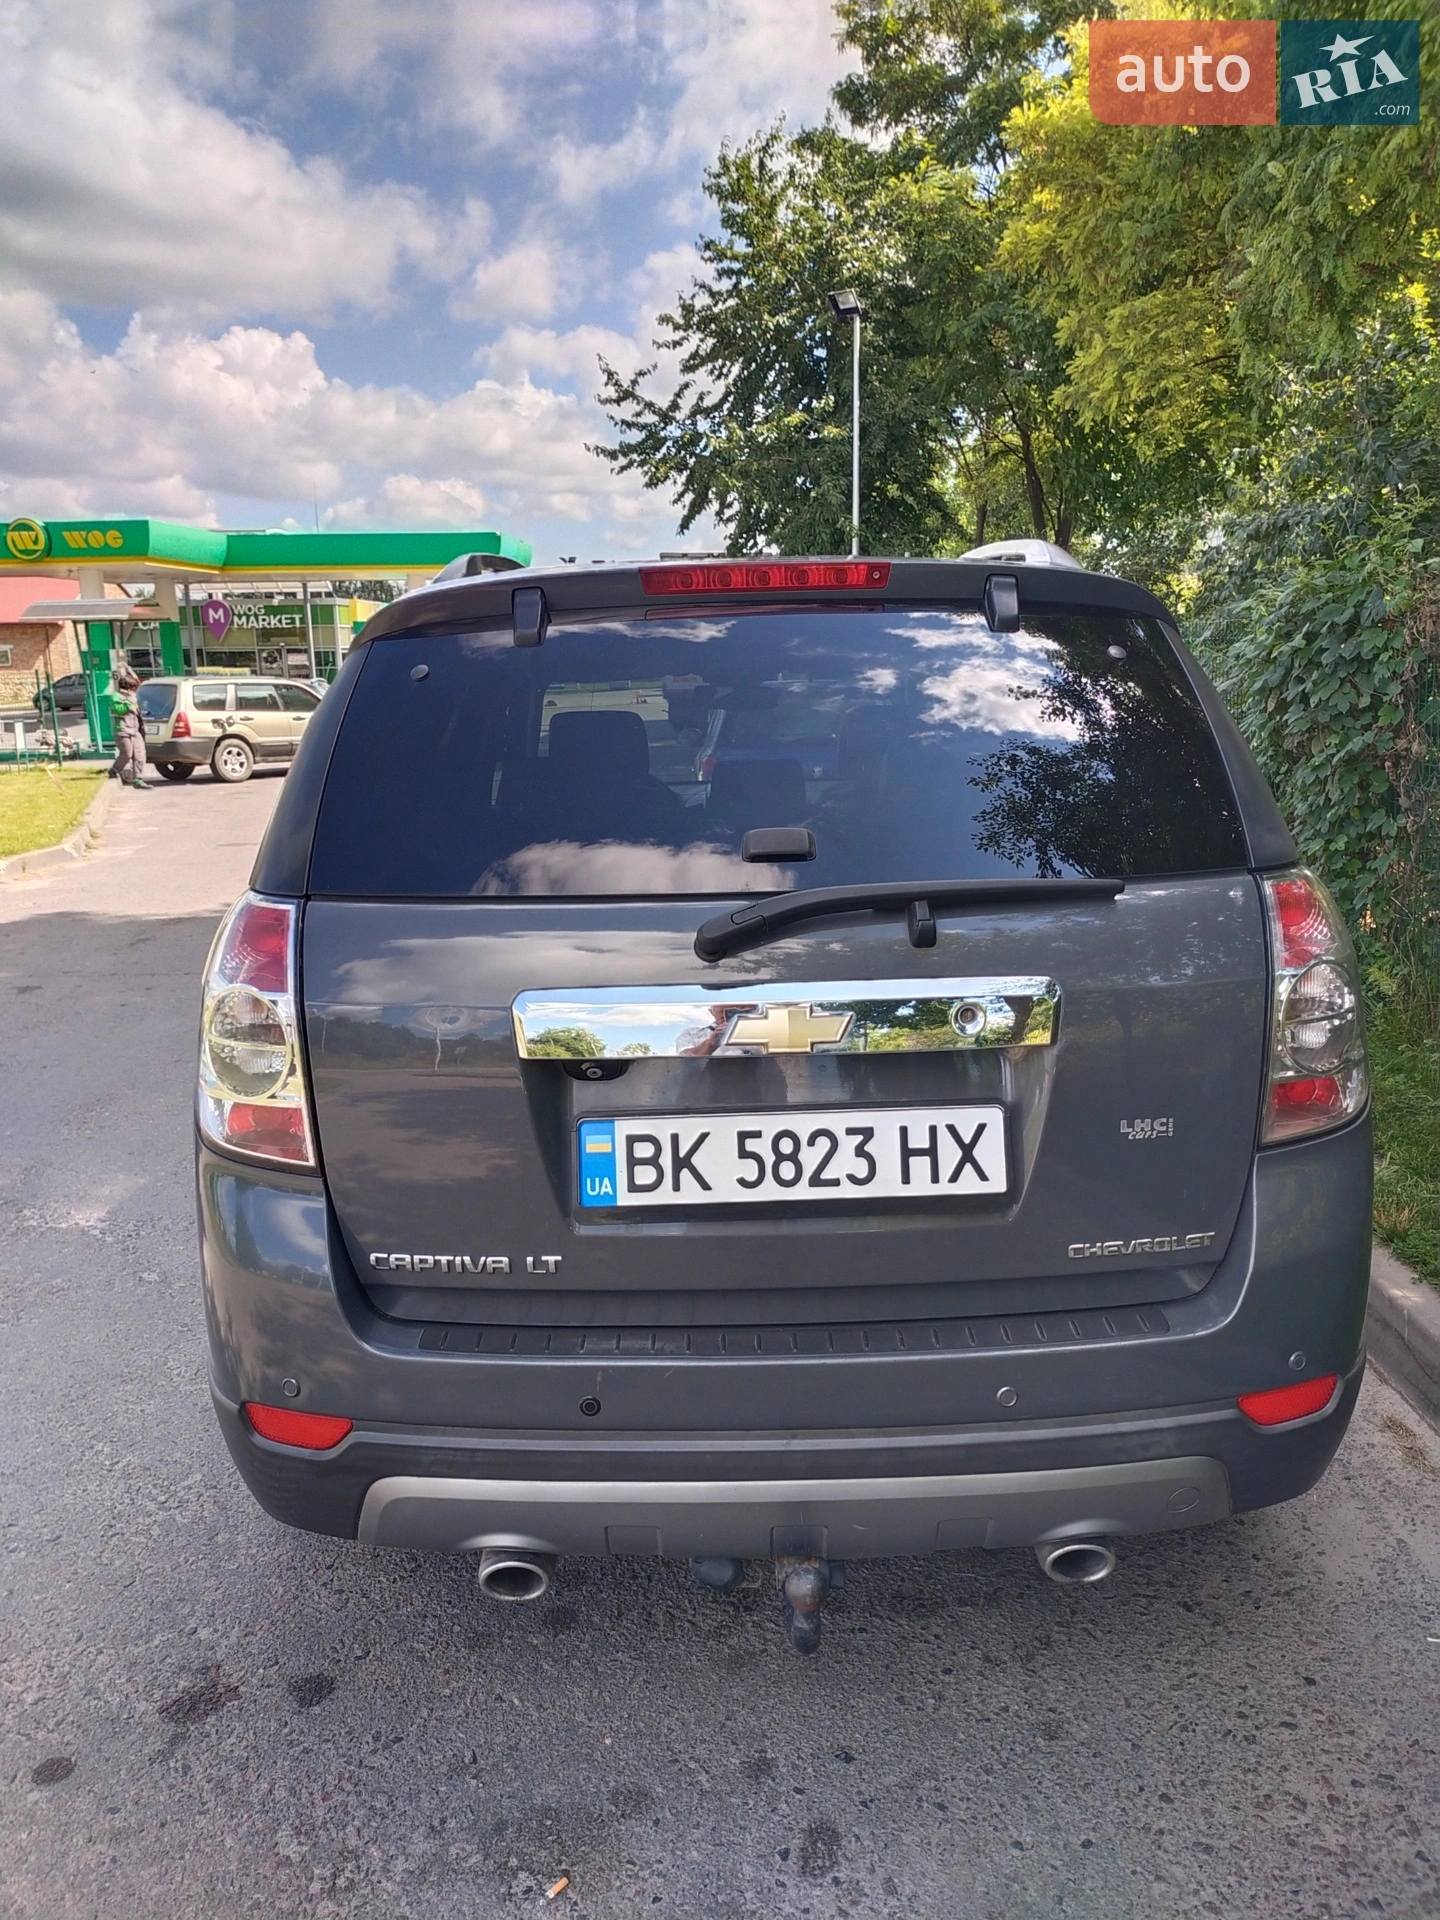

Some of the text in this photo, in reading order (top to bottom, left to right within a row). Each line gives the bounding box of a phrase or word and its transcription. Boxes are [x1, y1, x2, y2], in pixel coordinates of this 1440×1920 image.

[62, 530, 123, 548] WOG
[208, 608, 225, 623] M
[232, 604, 265, 615] WOG
[233, 614, 303, 629] MARKET
[1120, 1117, 1167, 1133] LHC
[1128, 1130, 1158, 1140] cars
[625, 1122, 990, 1193] BK 5823 HX
[586, 1177, 613, 1196] UA
[1068, 1231, 1216, 1259] CHEVROLET
[369, 1252, 562, 1275] CAPTIVA LT
